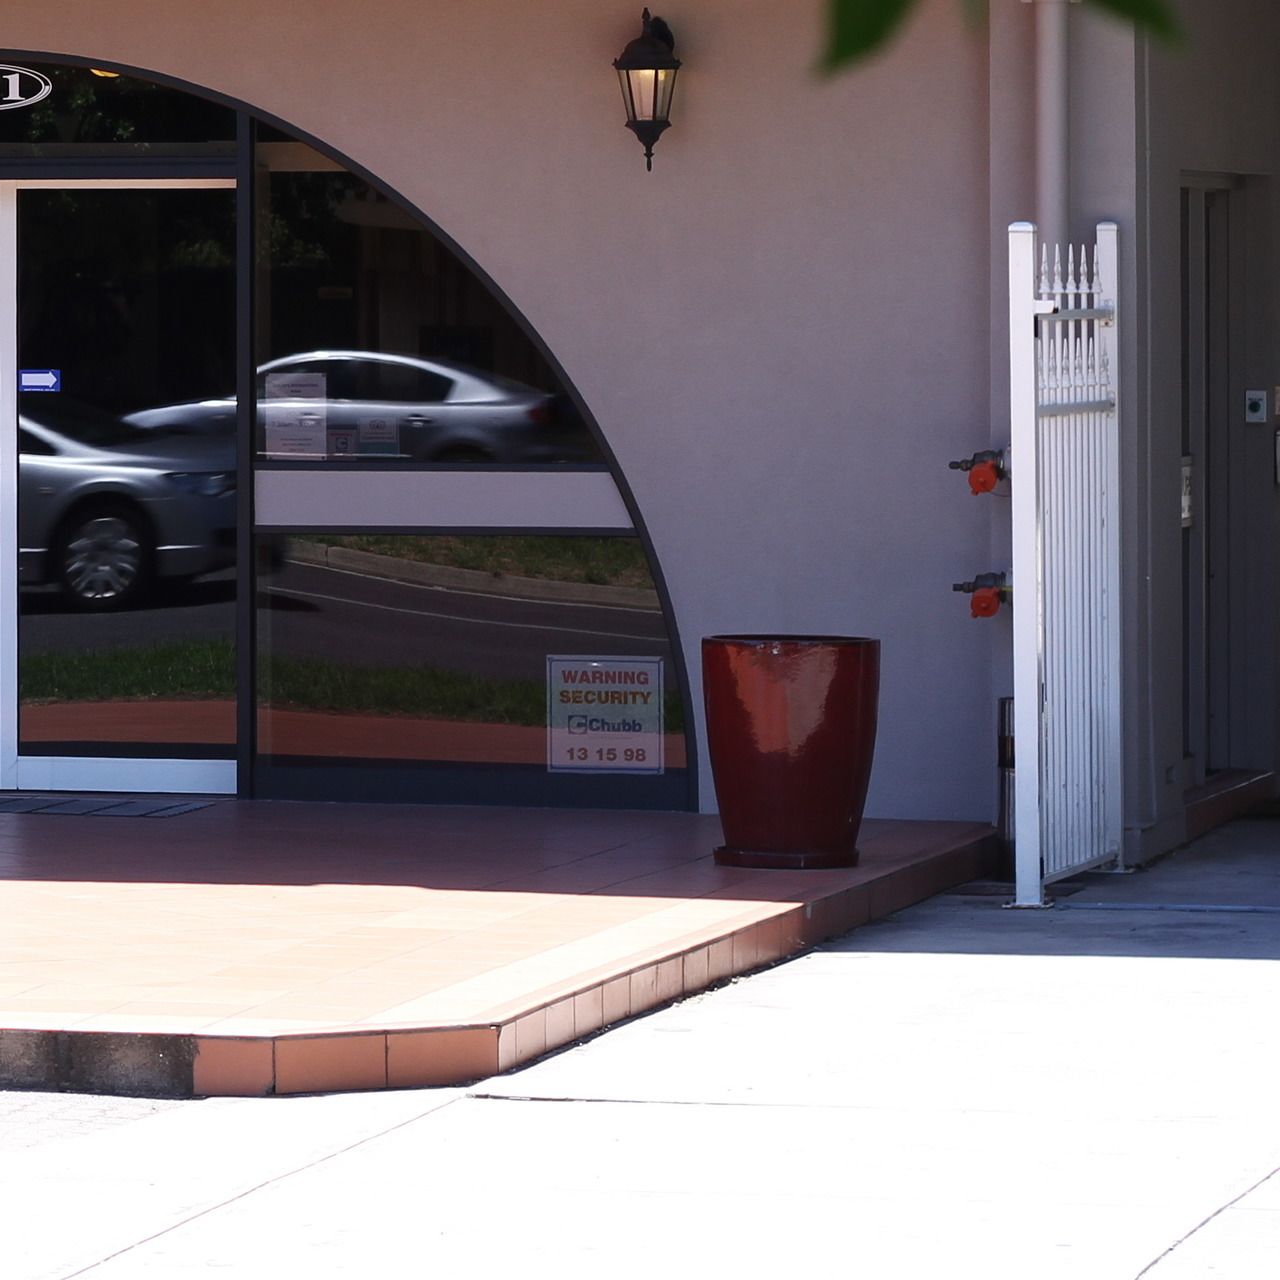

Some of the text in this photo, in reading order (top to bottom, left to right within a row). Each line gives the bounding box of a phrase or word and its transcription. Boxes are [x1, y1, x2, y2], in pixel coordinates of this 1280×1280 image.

[562, 670, 650, 685] WARNING
[559, 690, 653, 705] SECURITY
[589, 718, 643, 733] Chubb
[566, 748, 647, 762] 13 15 98
